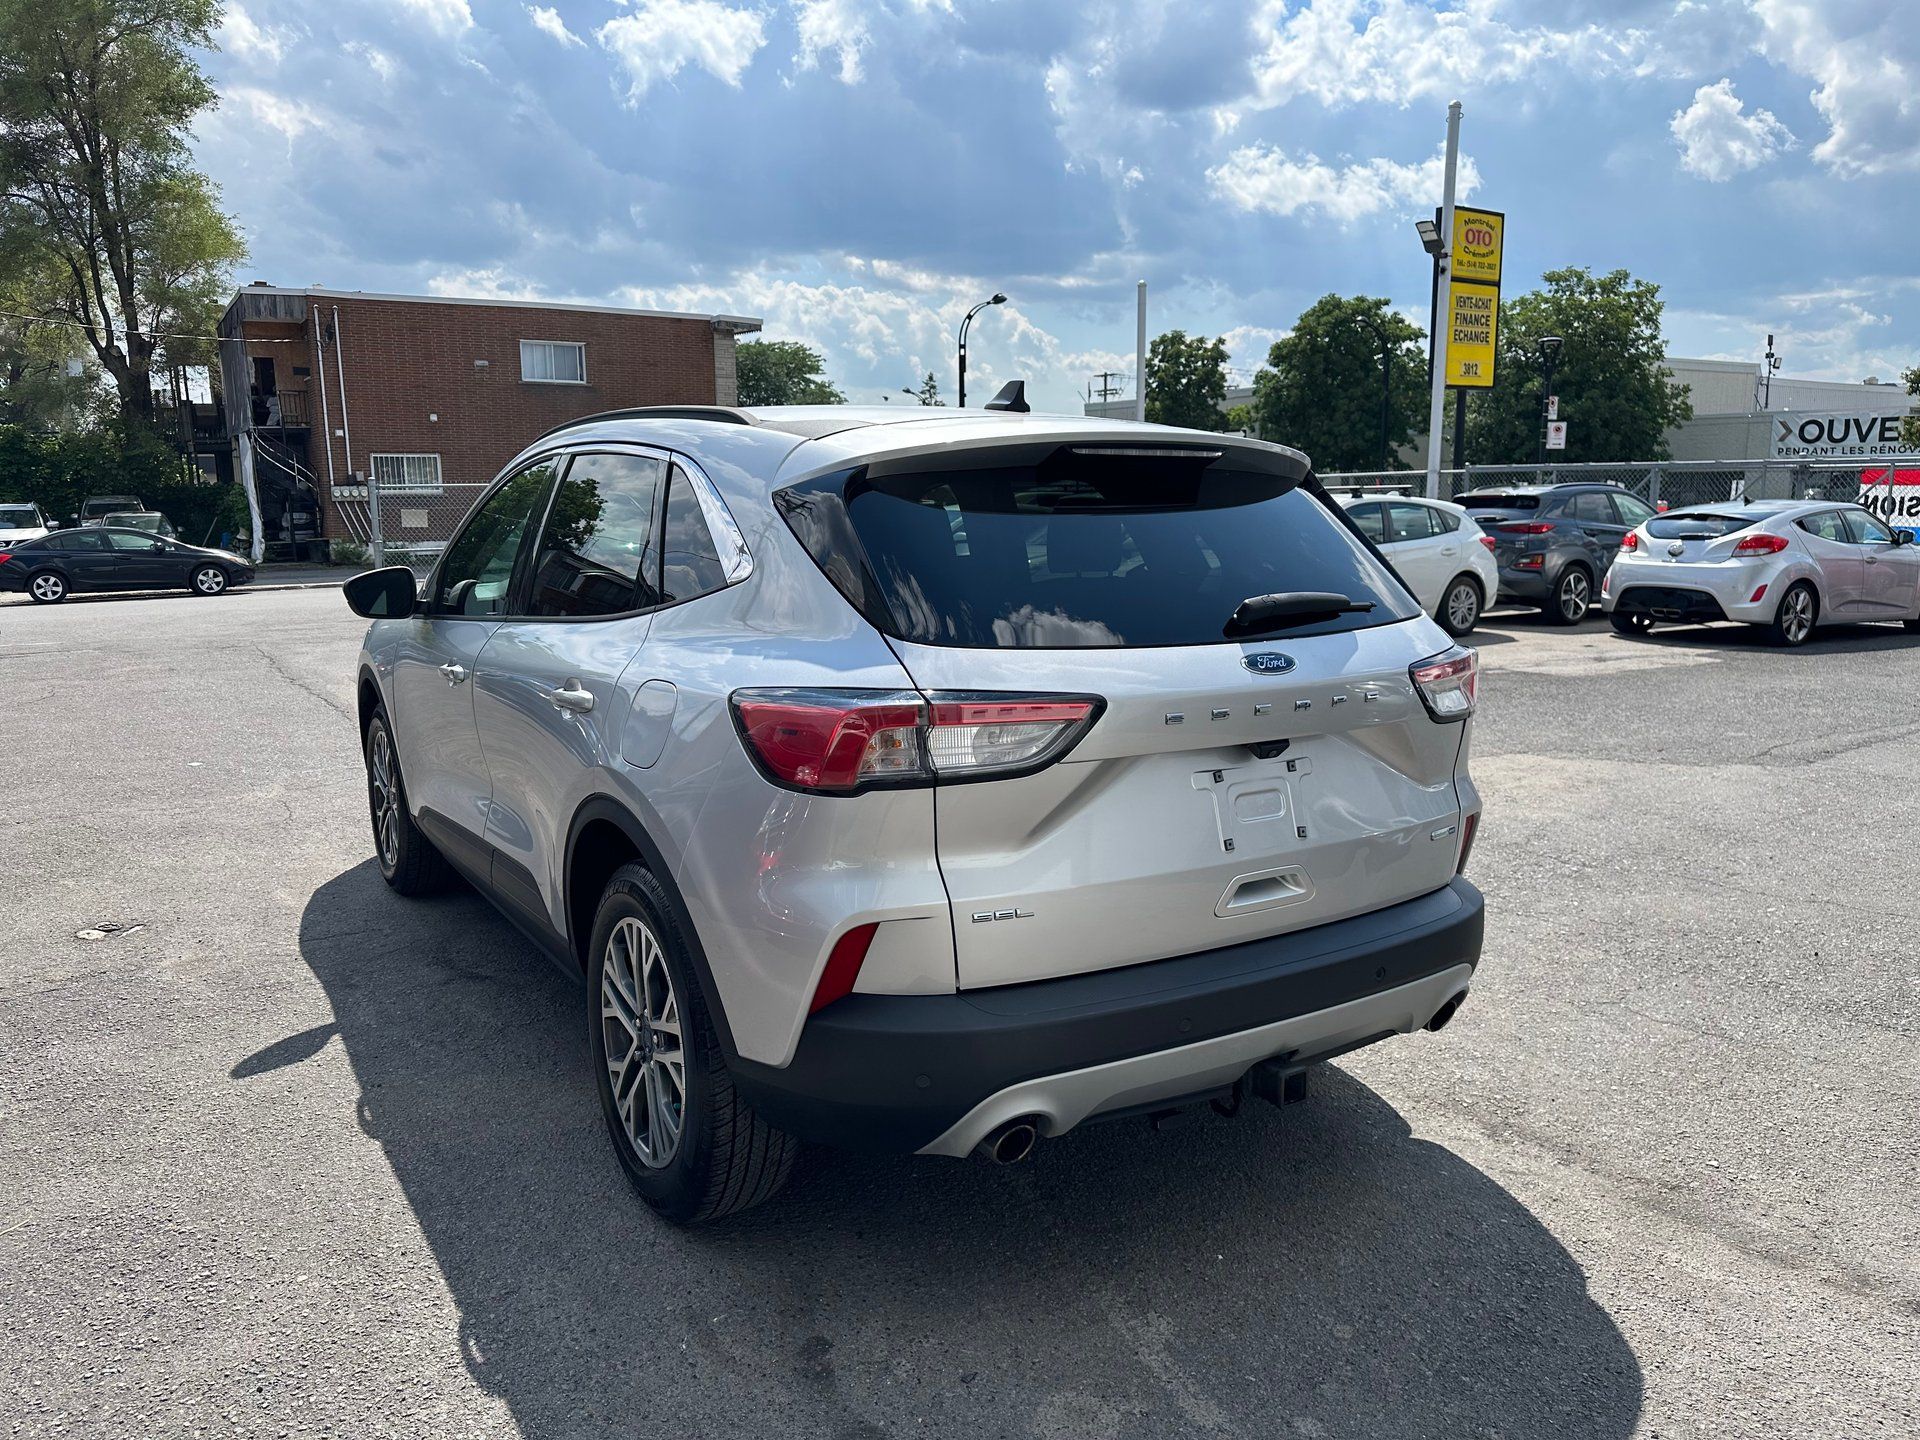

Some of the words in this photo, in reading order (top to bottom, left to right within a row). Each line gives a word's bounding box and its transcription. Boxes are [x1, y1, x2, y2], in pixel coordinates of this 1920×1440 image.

[1464, 217, 1495, 231] Montréal
[1465, 228, 1492, 247] OTO
[1455, 295, 1492, 311] VENTE-ACHAT
[1454, 312, 1490, 327] FINANCE
[1453, 329, 1490, 343] ECHANGE
[1462, 362, 1479, 376] 3812
[1777, 446, 1836, 456] PENDANT
[1841, 446, 1864, 455] LES
[1870, 443, 1920, 455] RÉNOV
[1257, 655, 1287, 669] Ford
[1165, 690, 1380, 726] ESCAPE
[971, 907, 1035, 924] SEL
